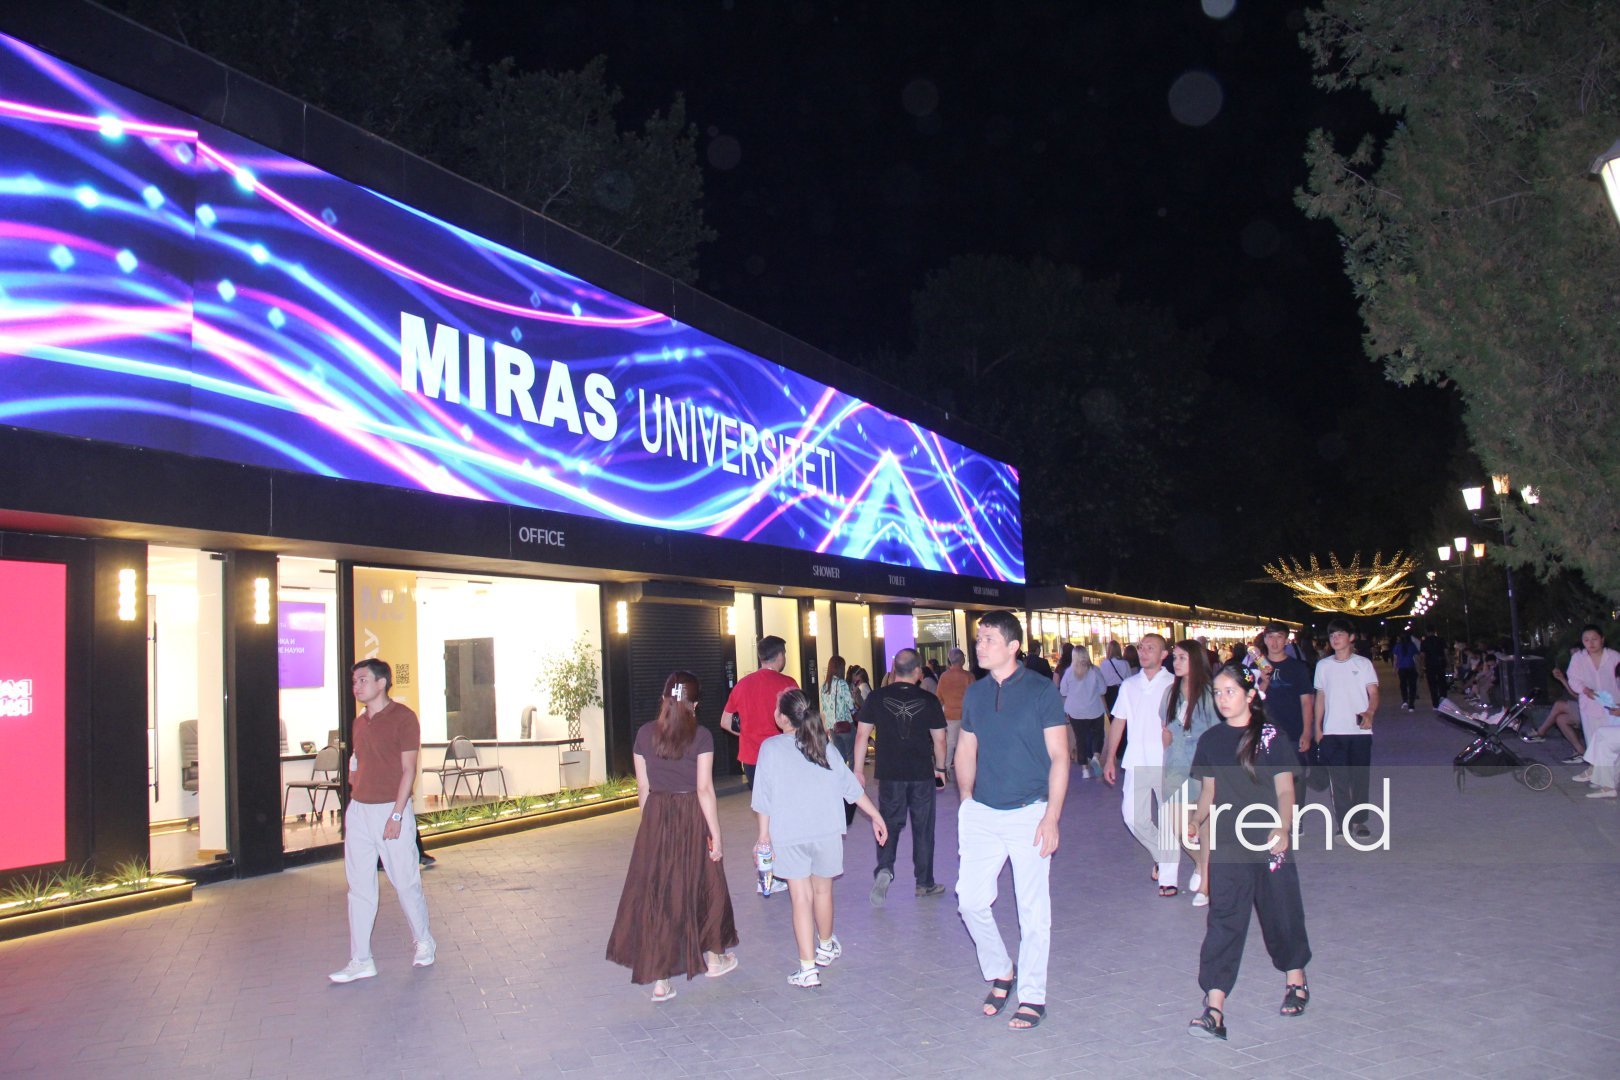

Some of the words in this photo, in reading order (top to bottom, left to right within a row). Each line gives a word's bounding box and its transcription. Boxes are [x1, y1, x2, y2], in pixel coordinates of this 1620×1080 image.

[400, 311, 618, 442] MIRAS
[639, 388, 837, 499] UNIVERSITETI
[519, 526, 565, 547] OFFICE
[812, 565, 840, 579] SHOWER
[888, 574, 905, 586] TOILET
